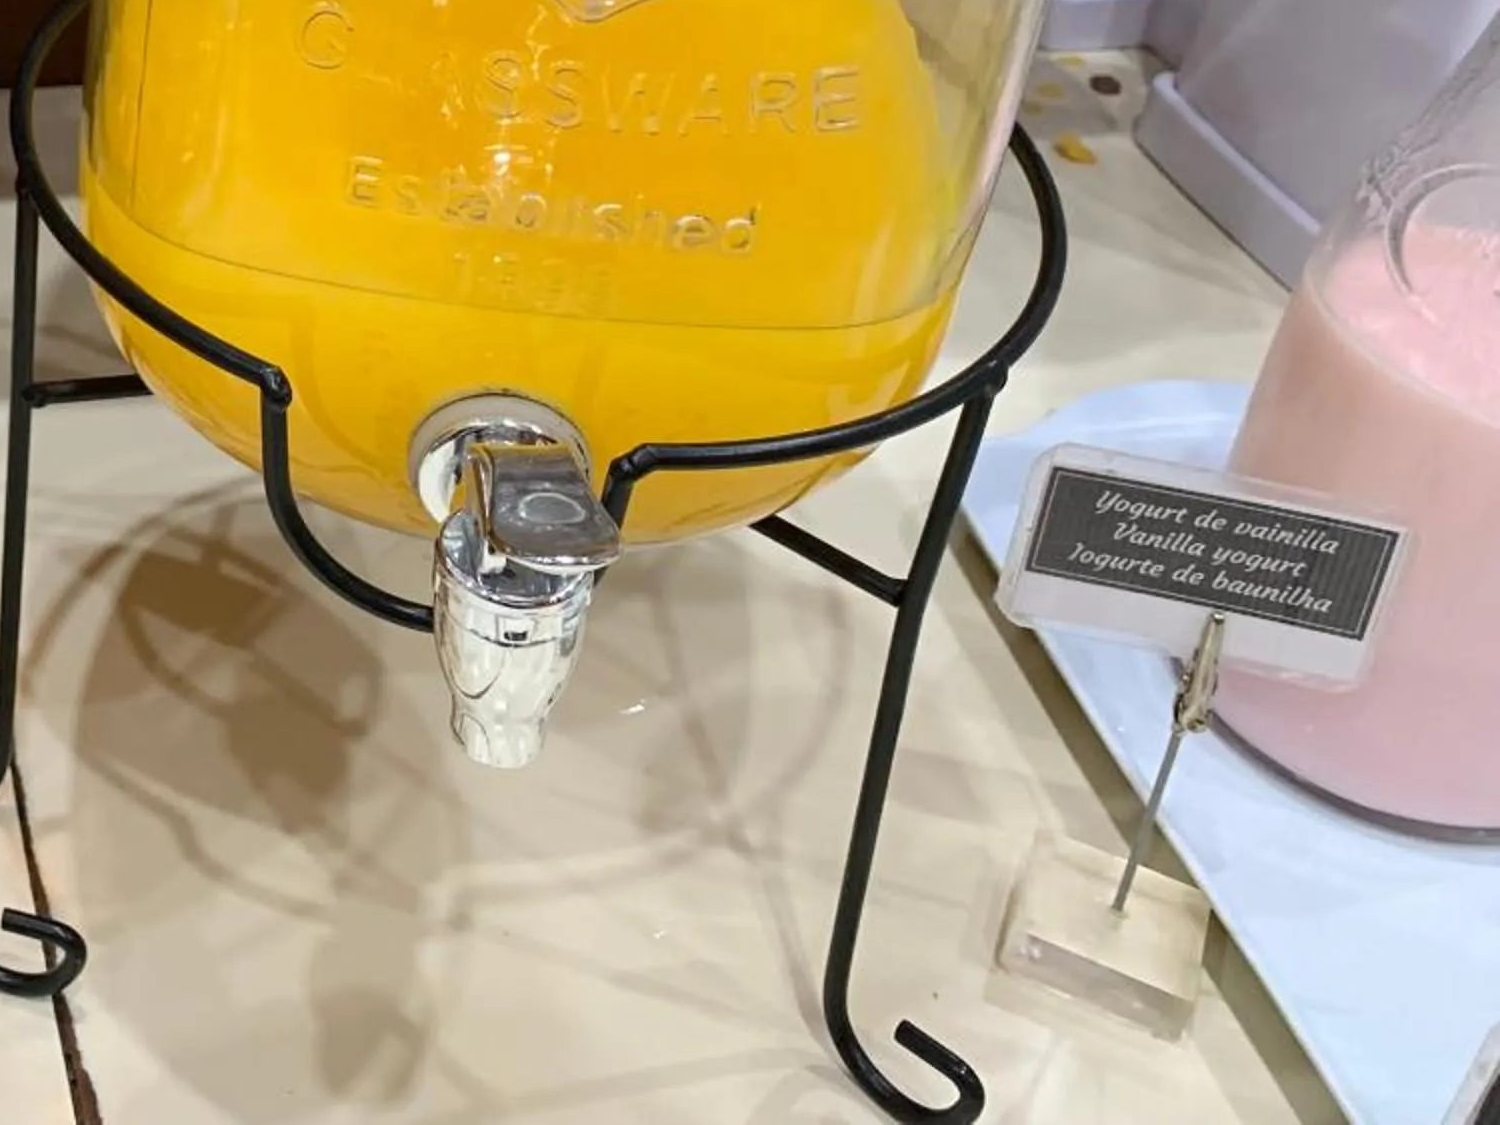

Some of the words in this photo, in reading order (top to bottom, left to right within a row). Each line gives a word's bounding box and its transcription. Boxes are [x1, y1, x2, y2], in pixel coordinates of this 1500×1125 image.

[300, 5, 862, 136] GSSWARE
[1095, 489, 1187, 524] Yogurt
[1194, 508, 1226, 532] de
[1233, 521, 1340, 556] vainilla
[1113, 521, 1206, 558] Vanilla
[1212, 545, 1307, 579] yogurt
[1066, 541, 1165, 578] Iogurte
[1172, 563, 1205, 588] de
[1211, 570, 1334, 614] baunilha
